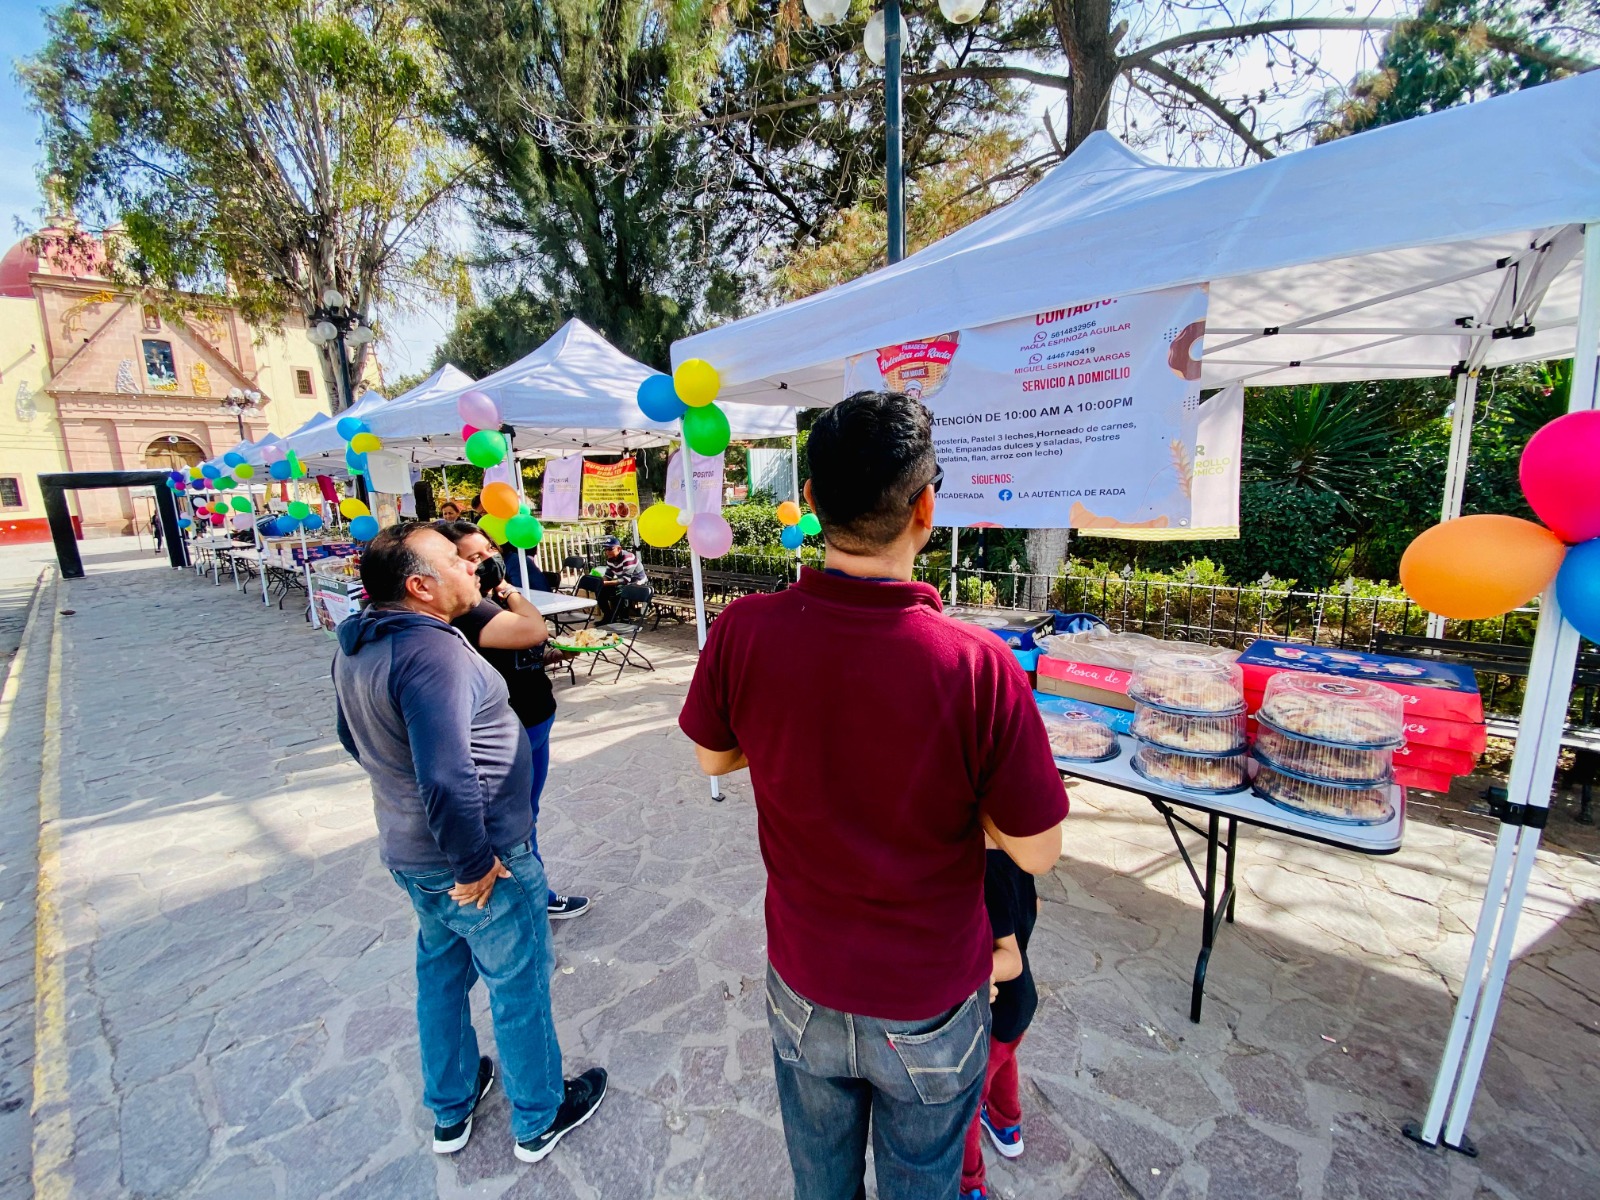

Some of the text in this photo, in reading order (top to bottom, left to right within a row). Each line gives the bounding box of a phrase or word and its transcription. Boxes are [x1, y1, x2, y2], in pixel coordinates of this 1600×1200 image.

[1020, 323, 1131, 352] PAOLA ESPINOZA AGUILAR
[926, 347, 953, 360] Rada
[1014, 351, 1131, 375] MIGUEL ESPINOZA VARGAS
[1022, 366, 1131, 392] SERVICIO A DOMICILIO
[985, 412, 1002, 422] DE
[1004, 408, 1037, 420] 10:00
[1040, 406, 1060, 417] AM
[1063, 404, 1073, 414] A
[1077, 396, 1133, 412] 10:00PM
[971, 434, 996, 443] Pastel
[1086, 425, 1099, 433] de
[1100, 421, 1137, 431] carnes,
[956, 444, 1002, 454] Empanadas
[1003, 442, 1034, 450] dulces
[1035, 441, 1042, 449] y
[1043, 437, 1083, 447] saladas,
[1085, 433, 1121, 443] Postres
[990, 452, 1014, 460] arroz
[1034, 448, 1063, 457] leche)
[1196, 457, 1231, 468] ROLLO
[971, 473, 1015, 485] SÍGUENOS:
[934, 491, 985, 500] TICADERADA
[1018, 491, 1030, 499] LA
[1084, 489, 1097, 497] DE
[1099, 488, 1126, 496] RADA
[1066, 662, 1100, 680] Rosca
[1104, 671, 1121, 684] de
